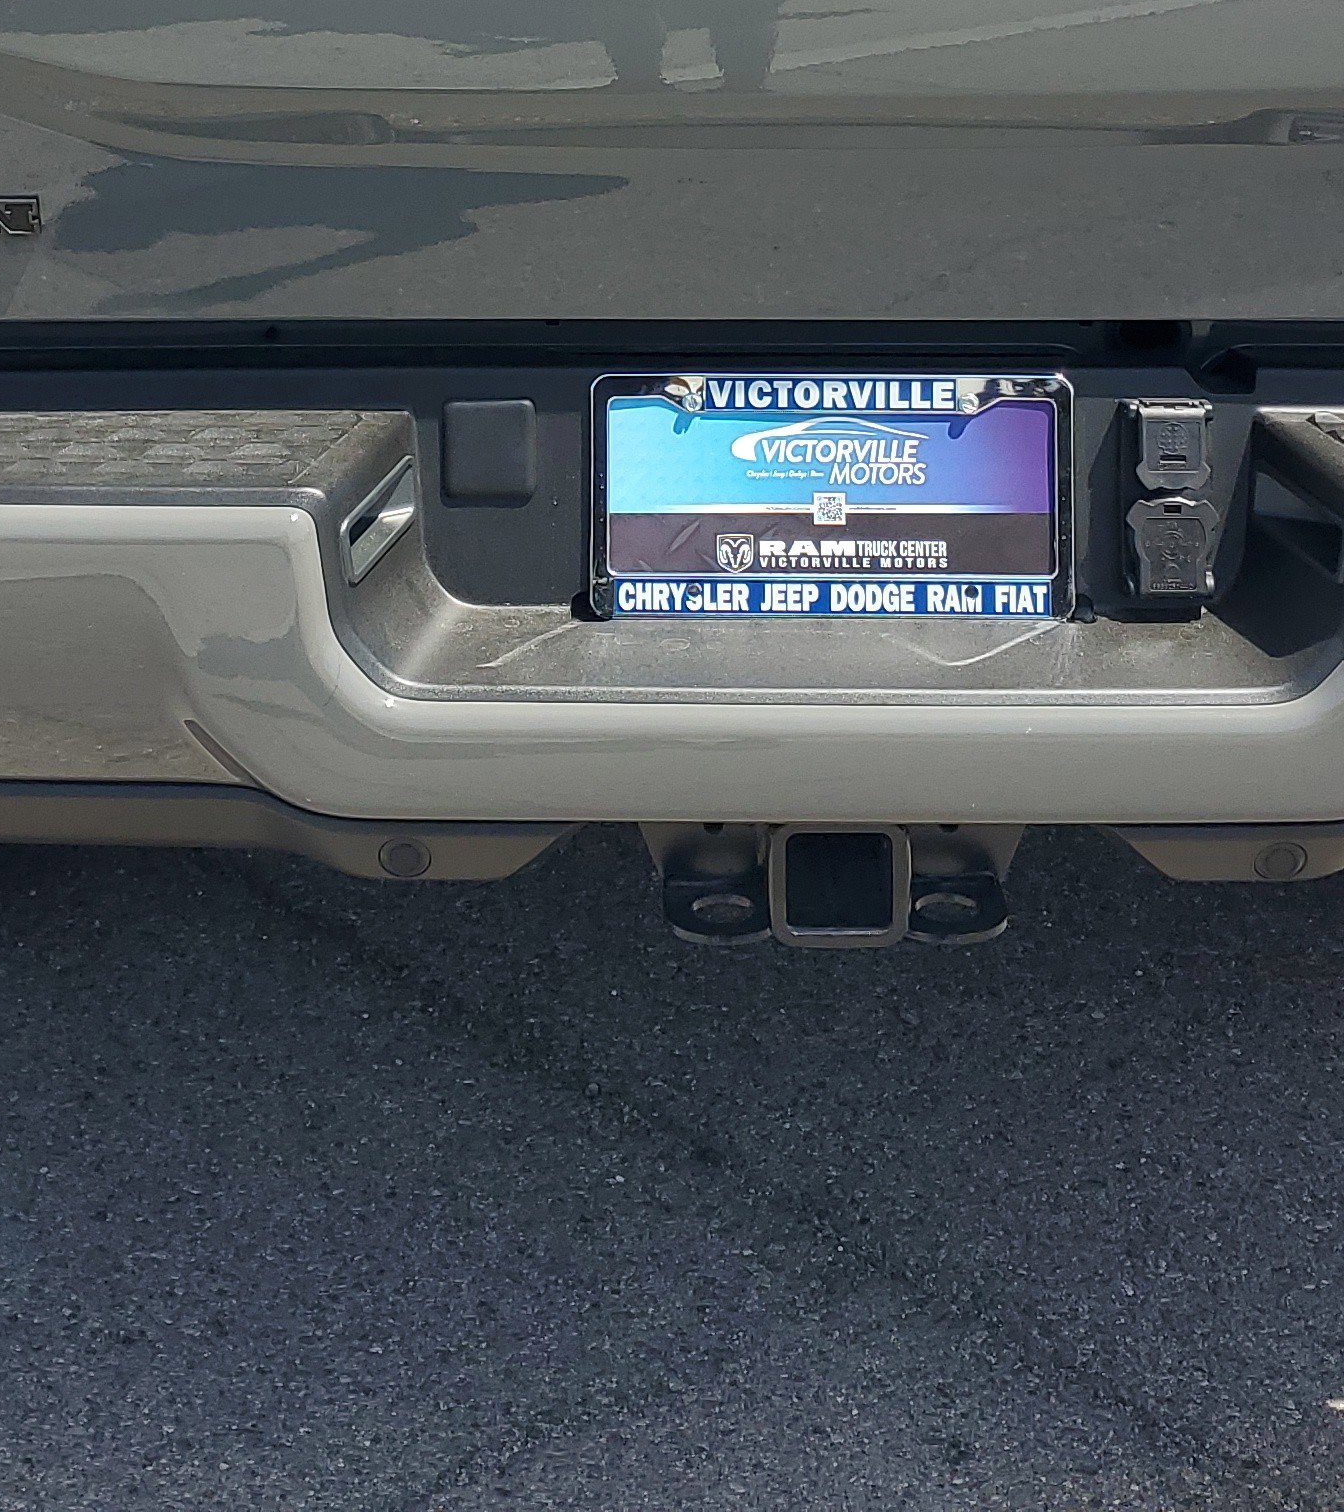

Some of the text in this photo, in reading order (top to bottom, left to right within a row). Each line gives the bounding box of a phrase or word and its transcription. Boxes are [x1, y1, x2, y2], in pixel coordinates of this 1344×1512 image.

[707, 379, 955, 410] VICTORVILLE
[761, 439, 920, 464] VICTORVILLE
[828, 462, 928, 485] MOTORS
[759, 540, 948, 557] RAM TRUCK CENTER
[759, 556, 949, 568] VICTORVILLE MOTORS
[618, 582, 1048, 614] CHRYSLER JEEP DODGE RAM FIAT
